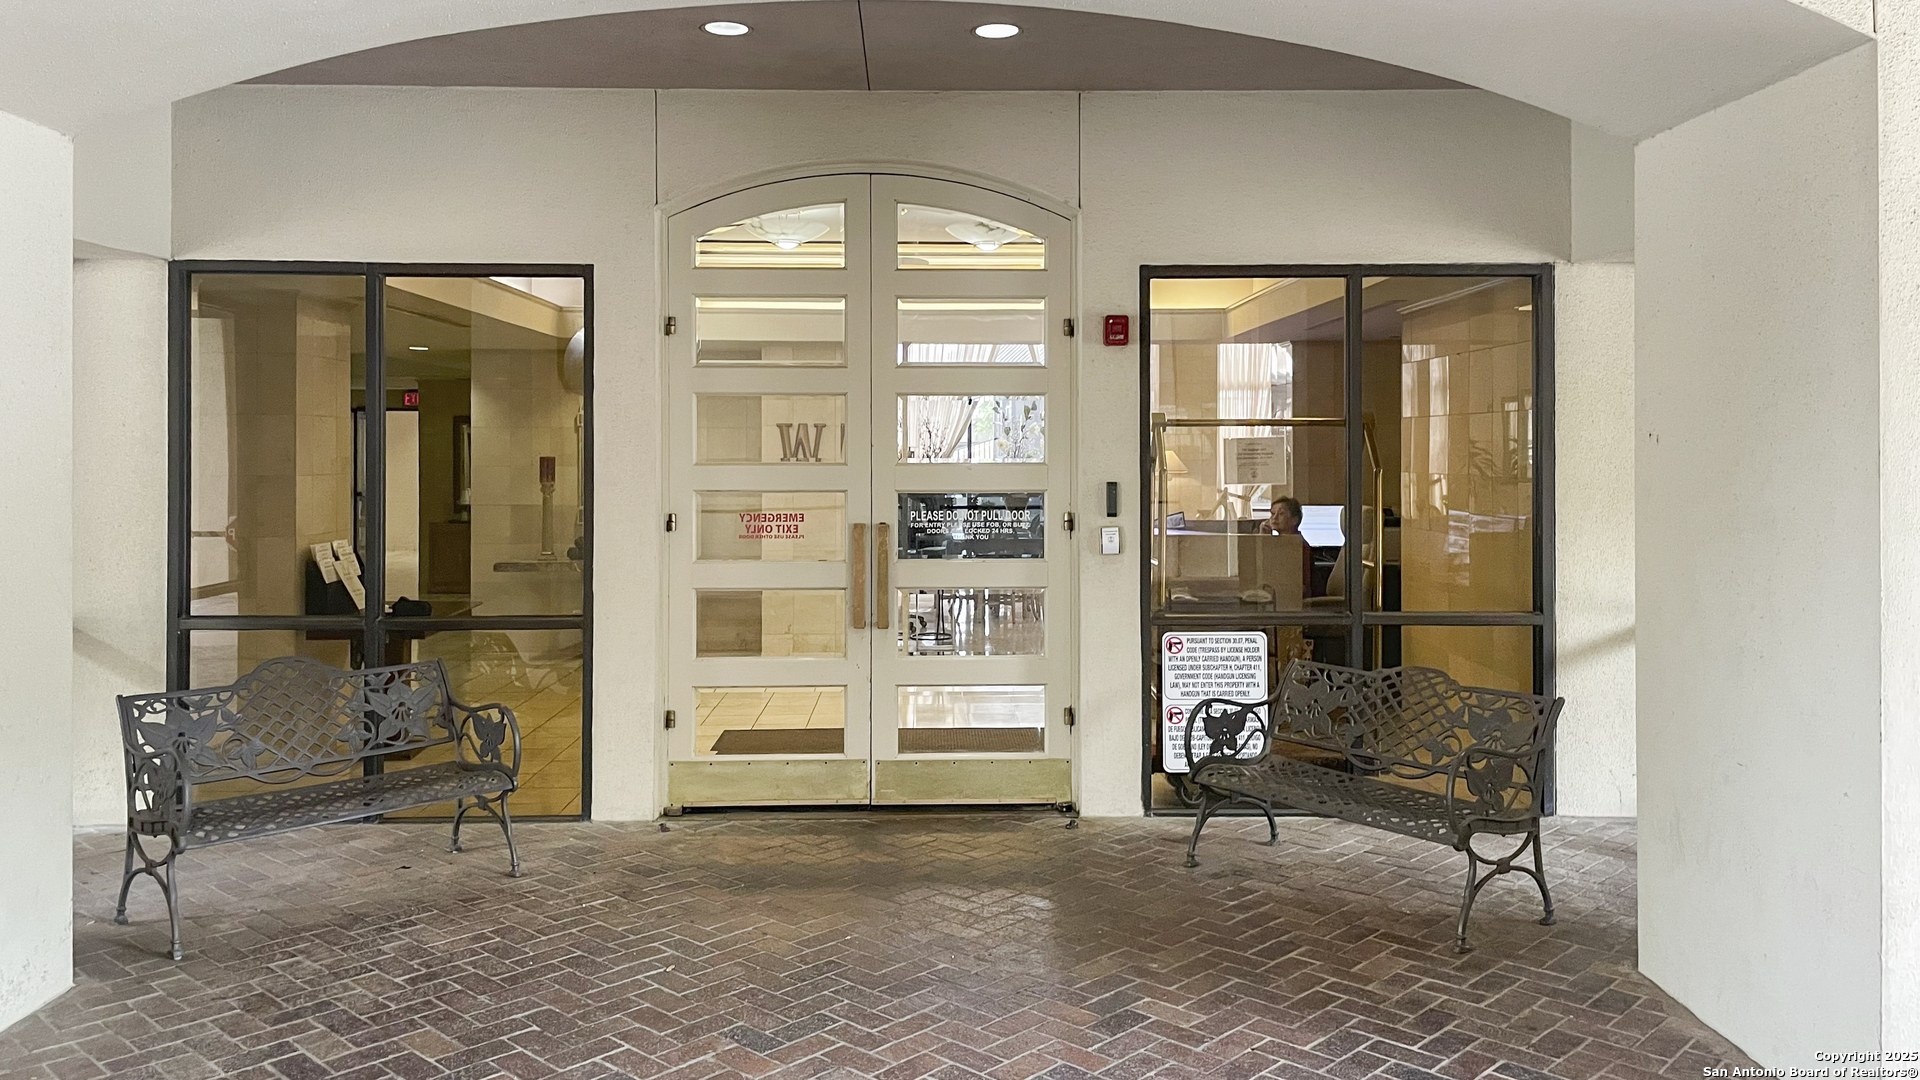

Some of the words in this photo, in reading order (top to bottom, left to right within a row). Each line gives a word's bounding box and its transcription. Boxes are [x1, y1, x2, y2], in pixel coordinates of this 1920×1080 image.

[404, 392, 419, 406] EXI
[910, 510, 944, 520] PLEASE
[946, 510, 958, 520] DO
[1006, 510, 1030, 520] DOOR
